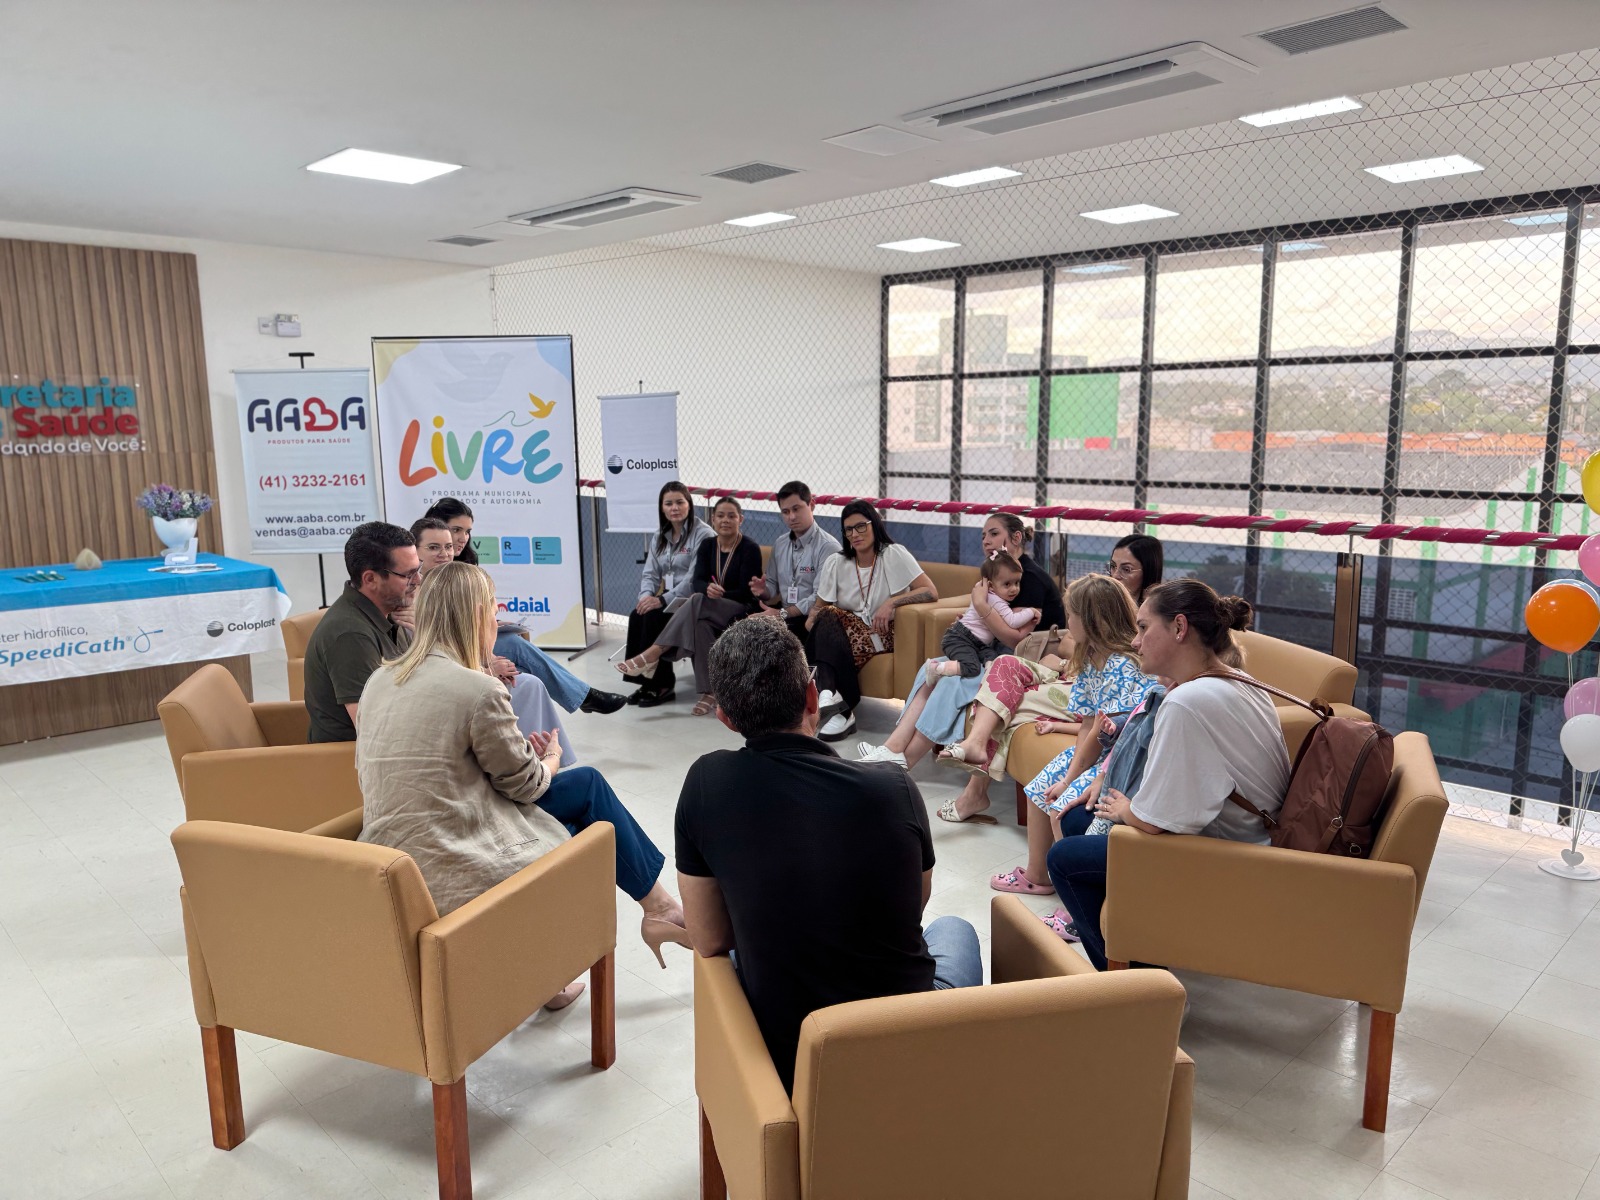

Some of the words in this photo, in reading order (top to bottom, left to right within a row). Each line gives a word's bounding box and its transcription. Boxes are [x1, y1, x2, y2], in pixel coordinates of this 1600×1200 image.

[0, 377, 136, 408] retaria
[13, 406, 139, 438] Saúde
[247, 397, 366, 432] AABA
[1, 440, 65, 455] dando
[68, 439, 92, 453] de
[626, 458, 678, 471] Coloplast
[259, 475, 287, 491] (41)
[292, 474, 367, 487] 3232-2161
[265, 512, 366, 524] www.aaba.com.br
[472, 541, 481, 550] V
[504, 541, 512, 550] R
[535, 541, 542, 550] E
[227, 617, 276, 633] Coloplast
